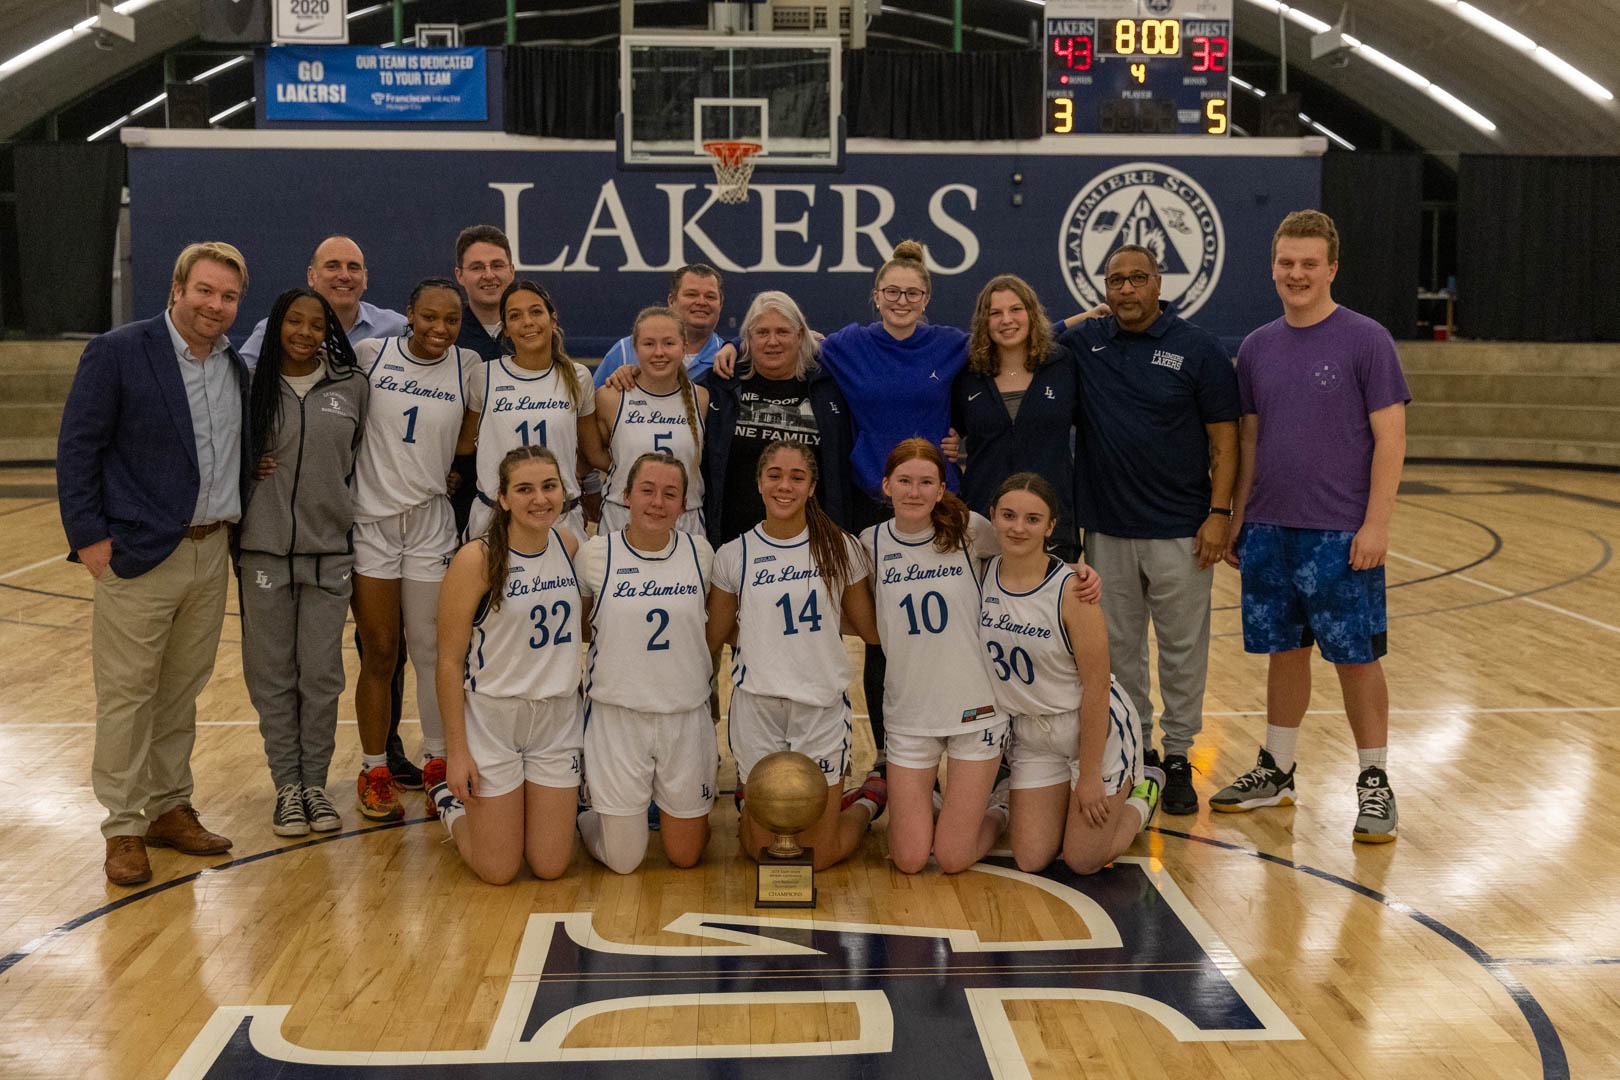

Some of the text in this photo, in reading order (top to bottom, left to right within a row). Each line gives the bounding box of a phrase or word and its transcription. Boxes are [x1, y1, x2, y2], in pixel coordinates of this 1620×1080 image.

[290, 0, 330, 14] 2020
[1048, 20, 1094, 35] LAKERS
[1115, 19, 1180, 54] 8:00
[1185, 21, 1229, 37] GUEST
[356, 55, 474, 70] OUR TEAM IS DEDICATED
[1053, 36, 1093, 70] 43
[1192, 37, 1229, 72] 32
[298, 61, 324, 82] GO
[380, 71, 451, 86] TO YOUR TEAM
[1130, 63, 1146, 83] 4
[276, 84, 347, 103] LAKERS!
[1054, 98, 1073, 133] 3
[1206, 99, 1227, 134] 5
[488, 178, 980, 276] LAKERS
[1162, 175, 1218, 269] SCHOOL
[1151, 356, 1182, 371] LAKERS
[374, 376, 457, 402] La Lumiere
[741, 392, 760, 401] NE
[493, 396, 571, 413] La Lumiere
[402, 406, 419, 444] 1
[625, 410, 692, 425] La Lumie
[515, 419, 547, 449] 11
[654, 431, 674, 460] 5
[734, 426, 821, 445] NE FAMILY
[752, 568, 777, 586] La
[882, 563, 963, 584] La Lumiere
[506, 575, 577, 598] La Lumiere
[613, 580, 698, 598] La Lumiere
[776, 589, 822, 635] 14
[899, 591, 948, 635] 10
[529, 600, 572, 650] 32
[645, 608, 670, 651] 2
[994, 614, 1051, 639] Lumiere
[986, 641, 1035, 685] 30
